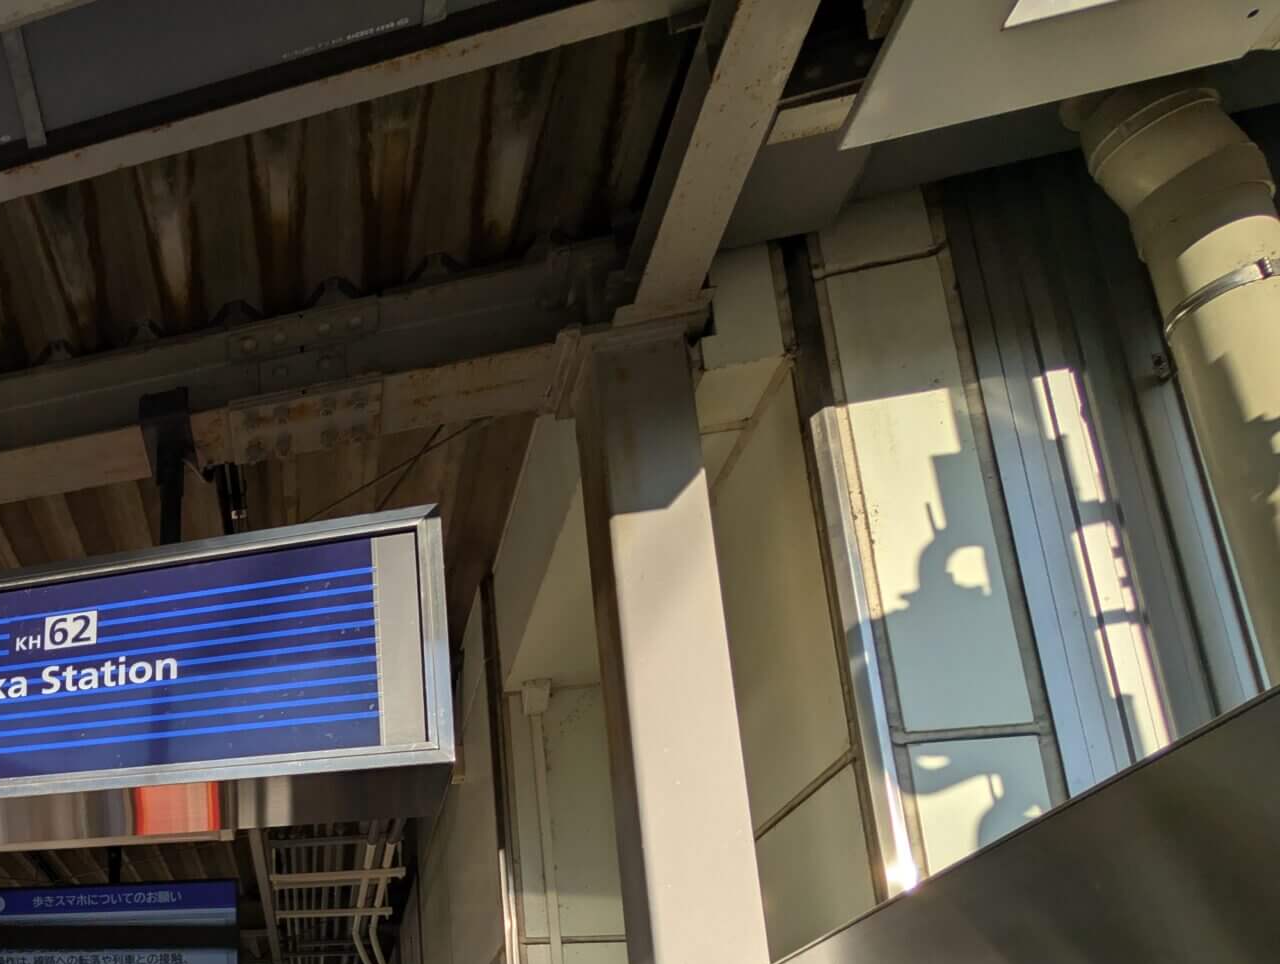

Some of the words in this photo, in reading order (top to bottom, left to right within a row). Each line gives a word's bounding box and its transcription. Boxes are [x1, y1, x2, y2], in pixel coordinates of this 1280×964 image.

[15, 634, 42, 652] KH
[48, 614, 93, 647] 62
[41, 656, 179, 695] Station
